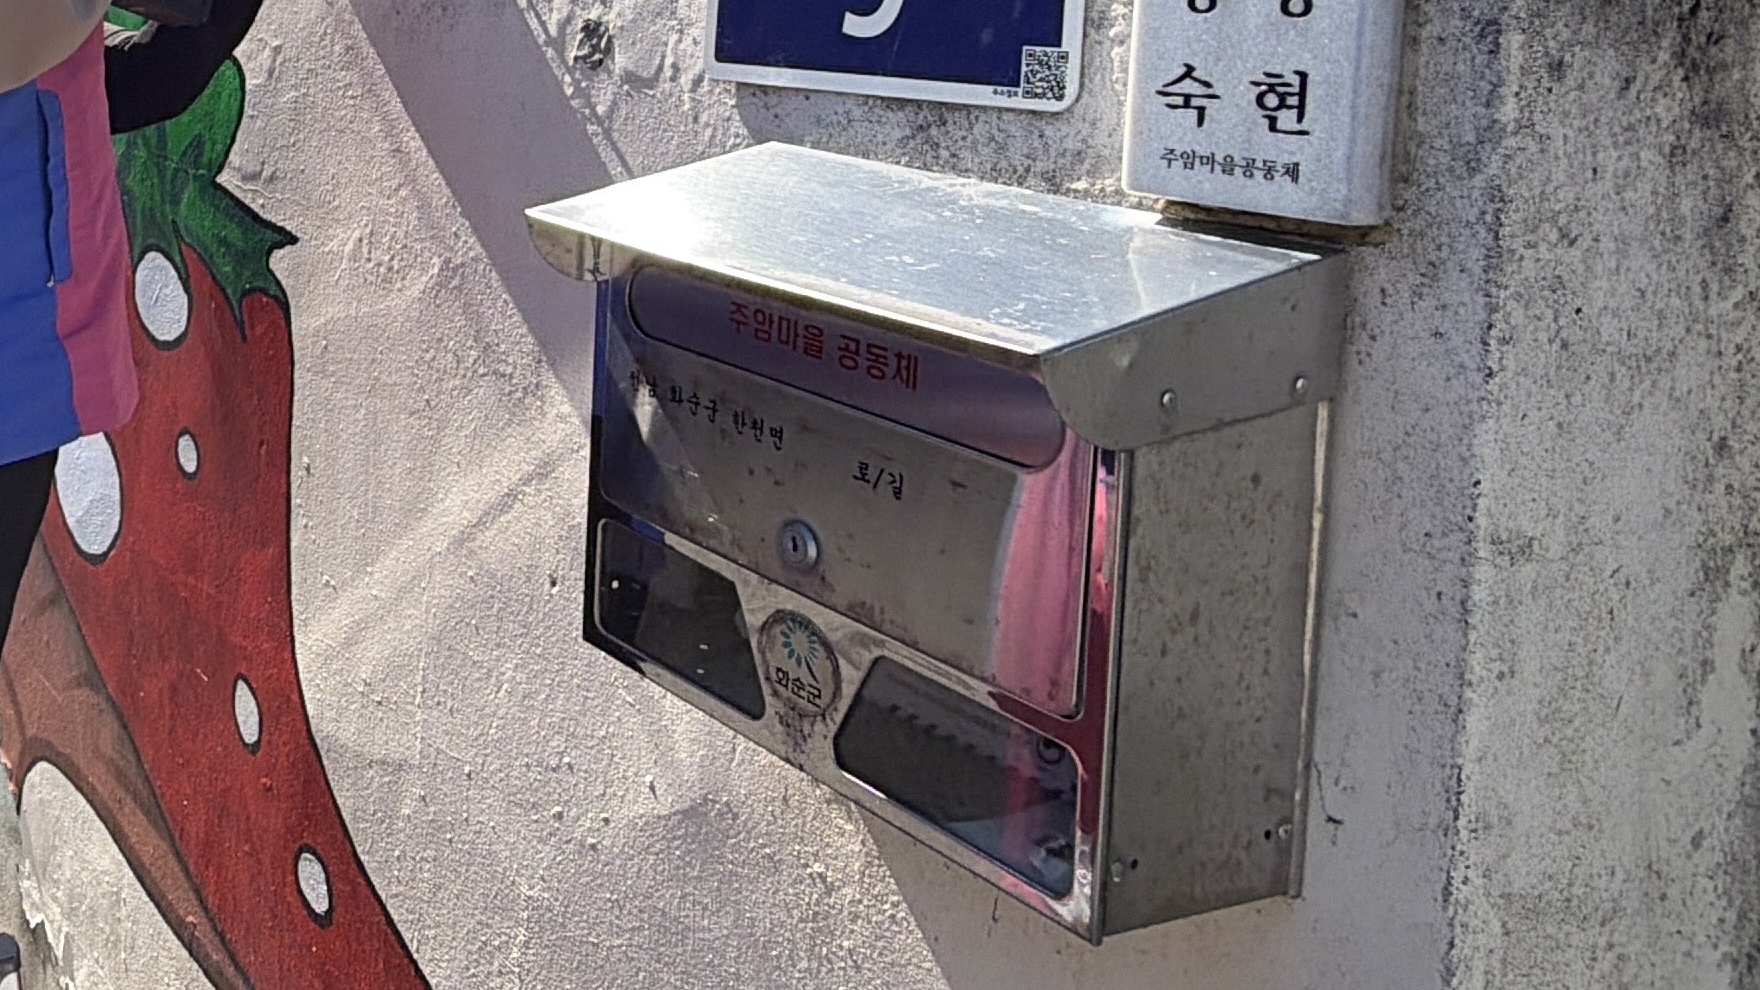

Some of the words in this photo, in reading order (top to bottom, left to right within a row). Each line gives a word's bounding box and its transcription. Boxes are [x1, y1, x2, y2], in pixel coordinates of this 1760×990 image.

[1159, 146, 1301, 185] 주암마을공동체
[729, 300, 825, 360] 주암마을
[837, 333, 919, 392] 공동체
[668, 385, 719, 424] 화순군
[732, 410, 784, 451] 한천면
[852, 460, 904, 501] 로/길
[774, 666, 823, 709] 화순군
